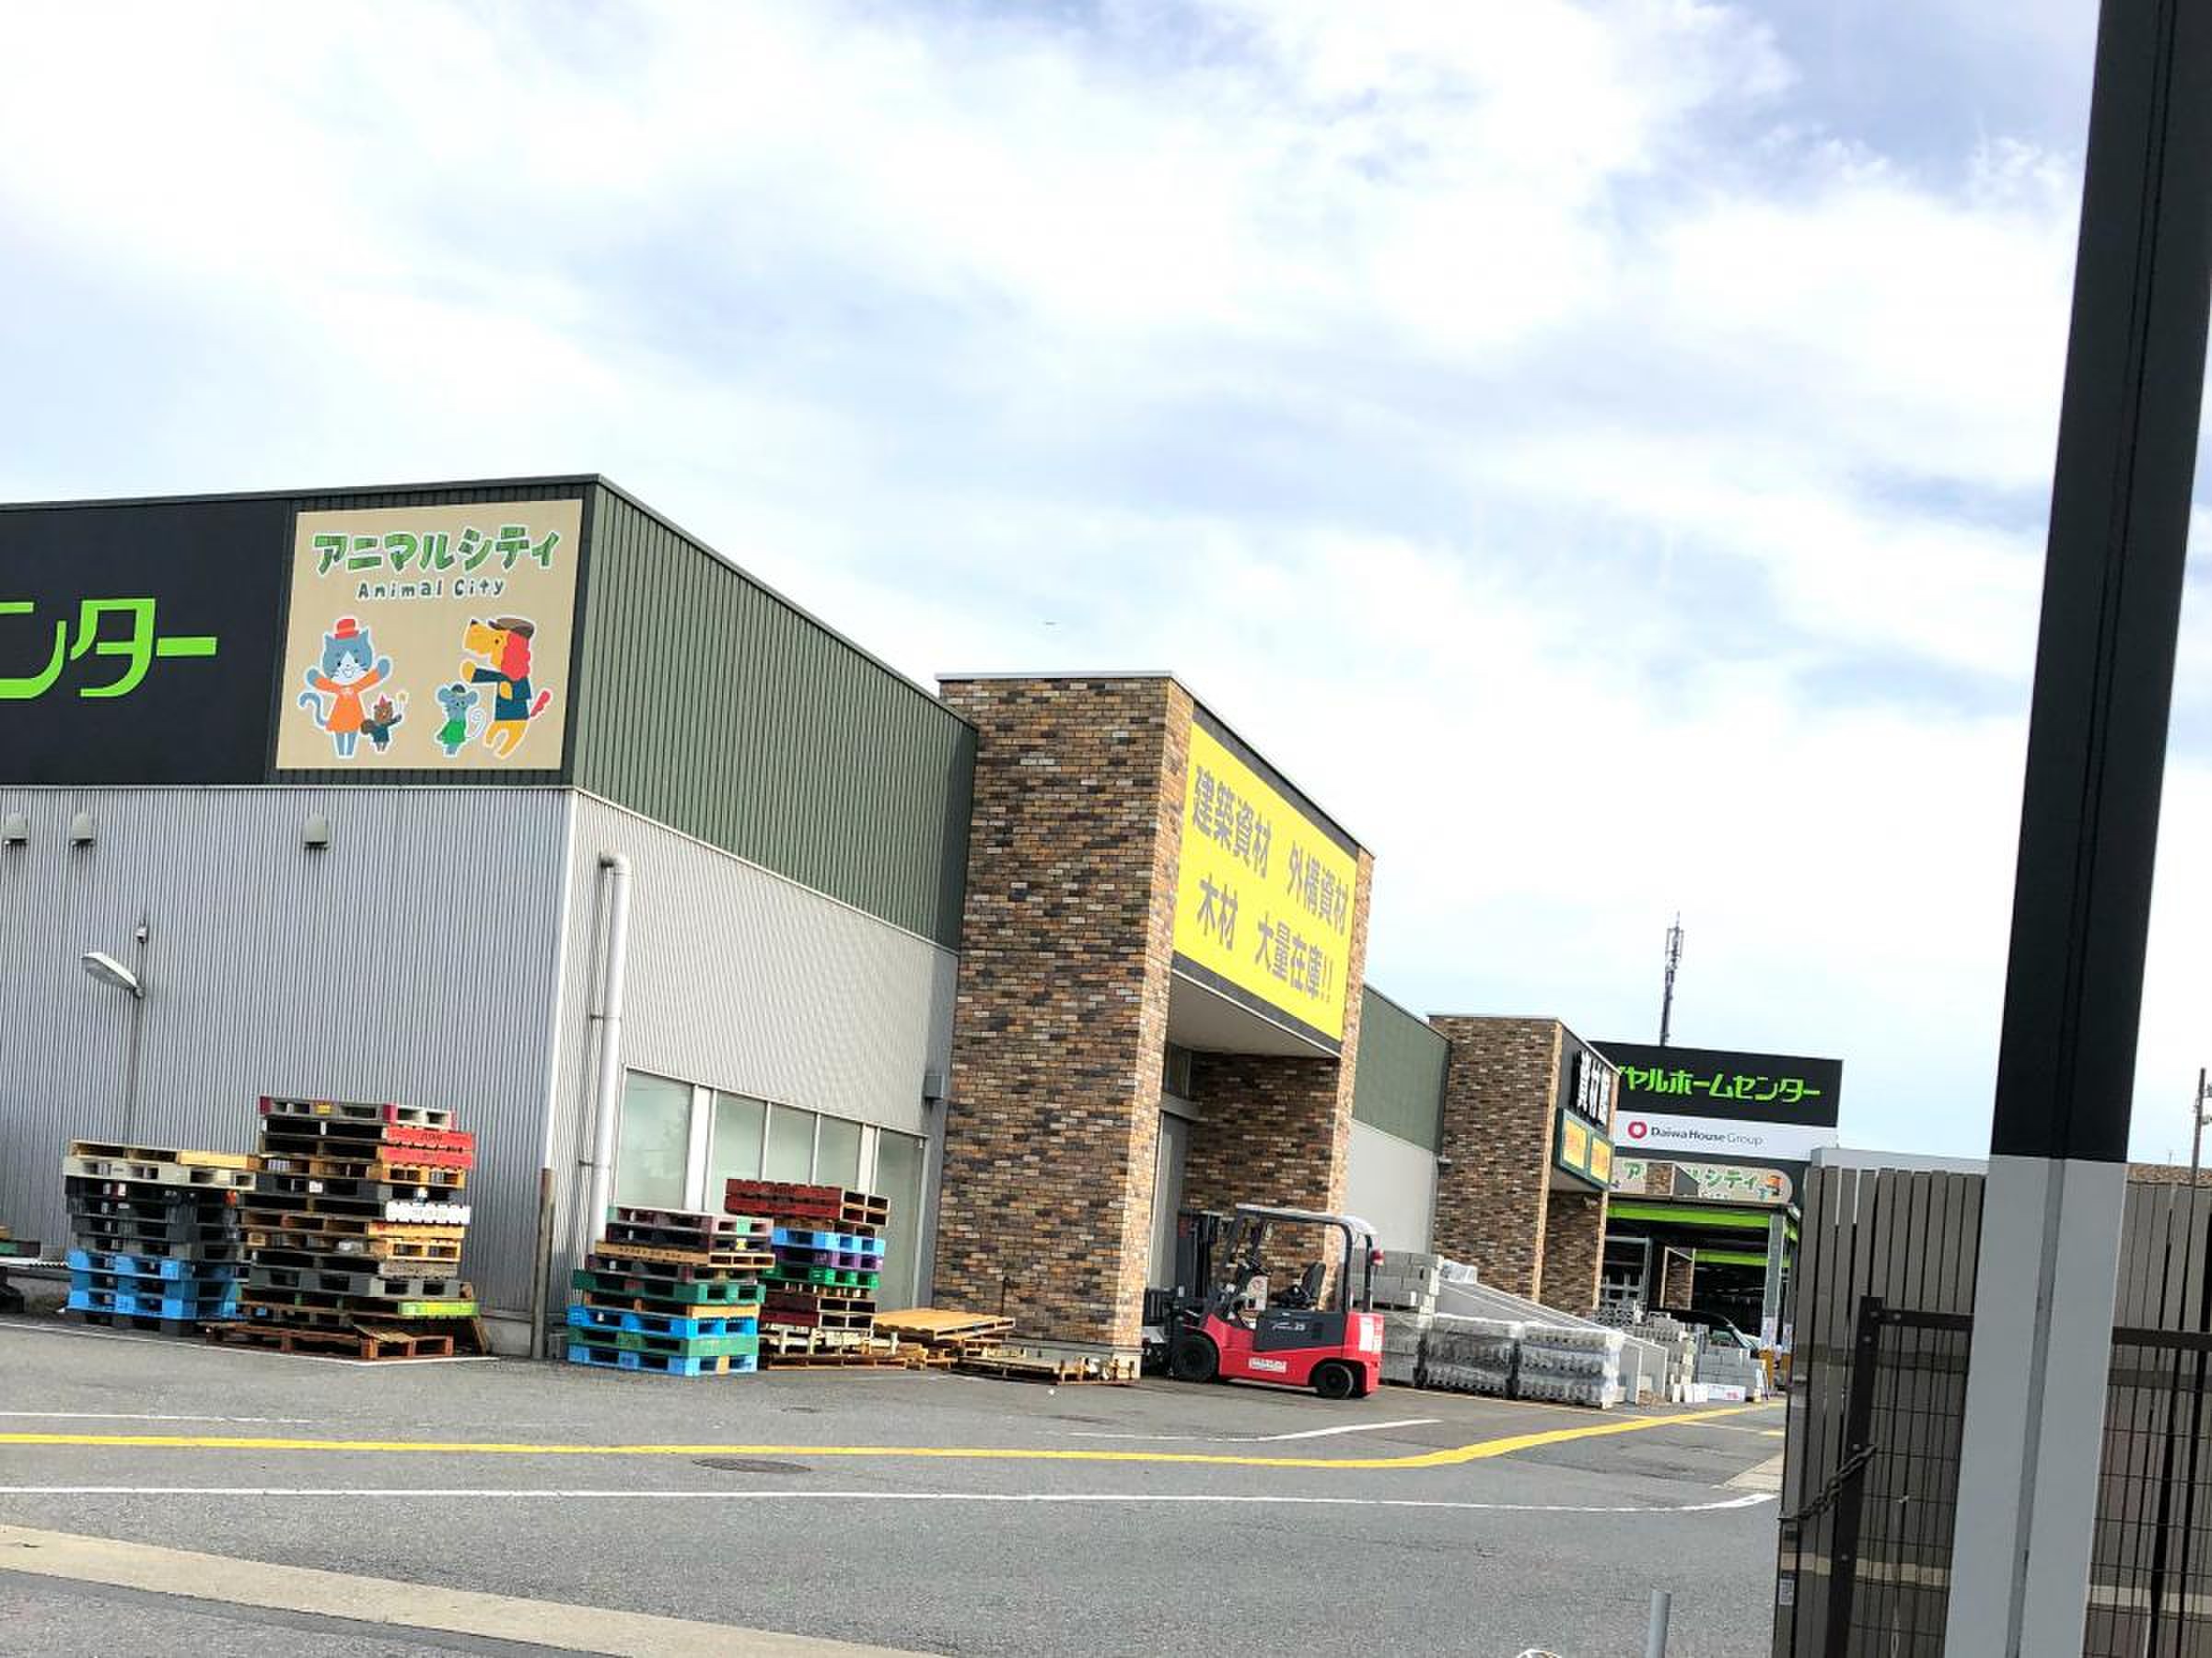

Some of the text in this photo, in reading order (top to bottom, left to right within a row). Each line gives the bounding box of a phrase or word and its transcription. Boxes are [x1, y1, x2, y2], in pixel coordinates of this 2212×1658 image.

[313, 525, 561, 574] アニマルシティ
[356, 578, 505, 600] Animal City
[1192, 764, 1273, 881] 建築資材
[1197, 872, 1240, 952] 木材
[1618, 1065, 1822, 1103] ヤルホームセンター
[1650, 1126, 1764, 1147] Daiwa House Group
